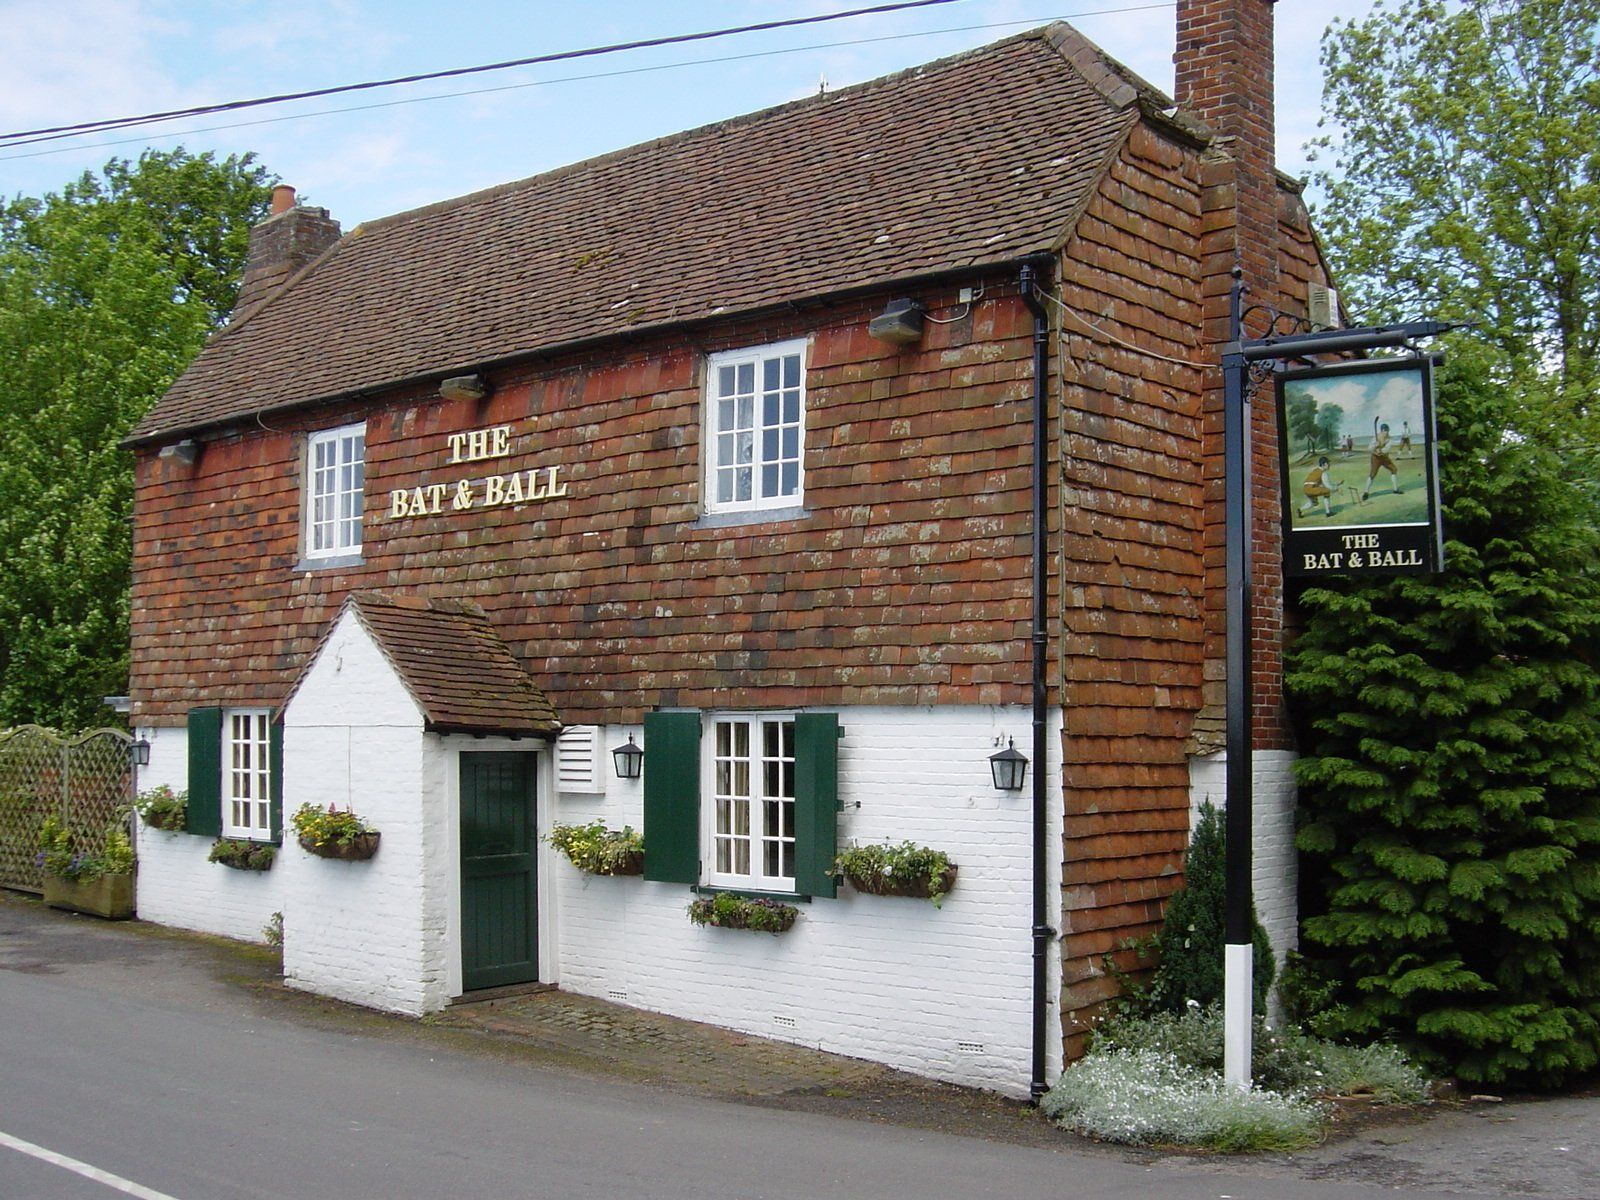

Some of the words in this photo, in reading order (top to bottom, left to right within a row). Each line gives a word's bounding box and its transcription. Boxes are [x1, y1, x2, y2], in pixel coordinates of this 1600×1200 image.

[448, 426, 511, 463] THE
[390, 484, 446, 519] BAT
[452, 479, 474, 510] &
[483, 466, 568, 507] BALL
[1342, 534, 1379, 549] THE
[1304, 553, 1343, 569] BAT
[1348, 551, 1363, 568] &
[1367, 549, 1423, 567] BALL
